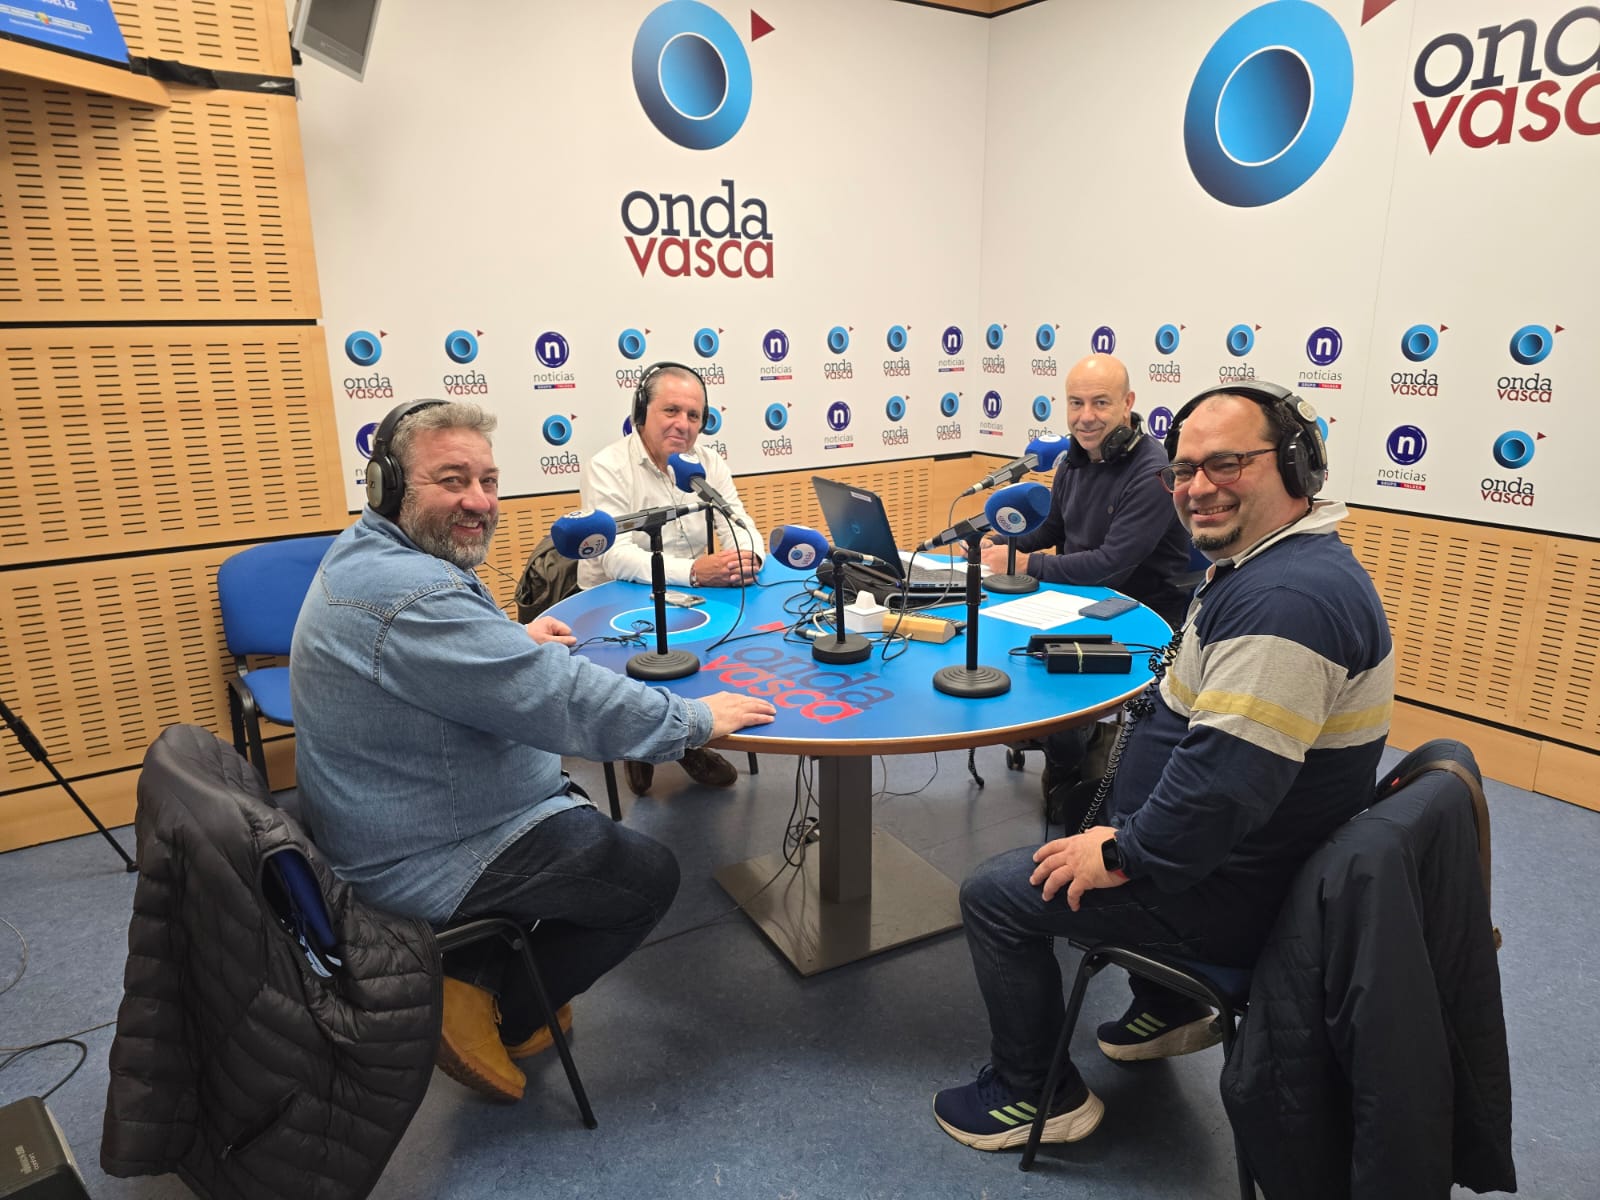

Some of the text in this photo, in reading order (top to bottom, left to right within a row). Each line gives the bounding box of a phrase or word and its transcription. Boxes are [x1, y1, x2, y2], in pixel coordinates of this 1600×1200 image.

[1414, 6, 1600, 98] ond
[1413, 72, 1600, 156] vasc
[621, 179, 773, 240] onda
[624, 236, 774, 278] vasca
[824, 359, 853, 372] onda
[883, 356, 910, 369] onda
[982, 354, 1005, 366] onda
[1031, 356, 1056, 369] onda
[616, 365, 643, 379] ond
[760, 365, 792, 374] noticias
[883, 368, 910, 377] vasca
[983, 364, 1005, 374] vasca
[1032, 367, 1057, 376] vasca
[1149, 360, 1180, 375] onda
[1219, 363, 1255, 377] onda
[344, 373, 392, 389] onda
[443, 370, 487, 386] onda
[534, 371, 575, 382] noticias
[702, 376, 725, 385] sca
[824, 370, 853, 380] vasca
[1149, 373, 1180, 383] vasca
[1299, 369, 1342, 381] noticias
[1391, 369, 1438, 386] onda
[617, 379, 638, 388] vas
[1497, 373, 1552, 391] onda
[345, 387, 393, 399] vasca
[445, 383, 488, 395] vasca
[1391, 383, 1438, 397] vasca
[1497, 388, 1552, 403] vasca
[882, 426, 908, 438] onda
[936, 421, 960, 433] onda
[762, 435, 792, 449] onda
[824, 434, 853, 443] noticias
[882, 436, 909, 445] vasca
[937, 432, 961, 440] vasca
[762, 446, 792, 456] vasca
[540, 451, 579, 467] onda
[541, 463, 580, 475] vasca
[1378, 468, 1427, 482] noticias
[1480, 477, 1534, 495] onda
[1481, 490, 1534, 507] vasca
[734, 647, 895, 711] onda
[701, 655, 865, 725] vasca
